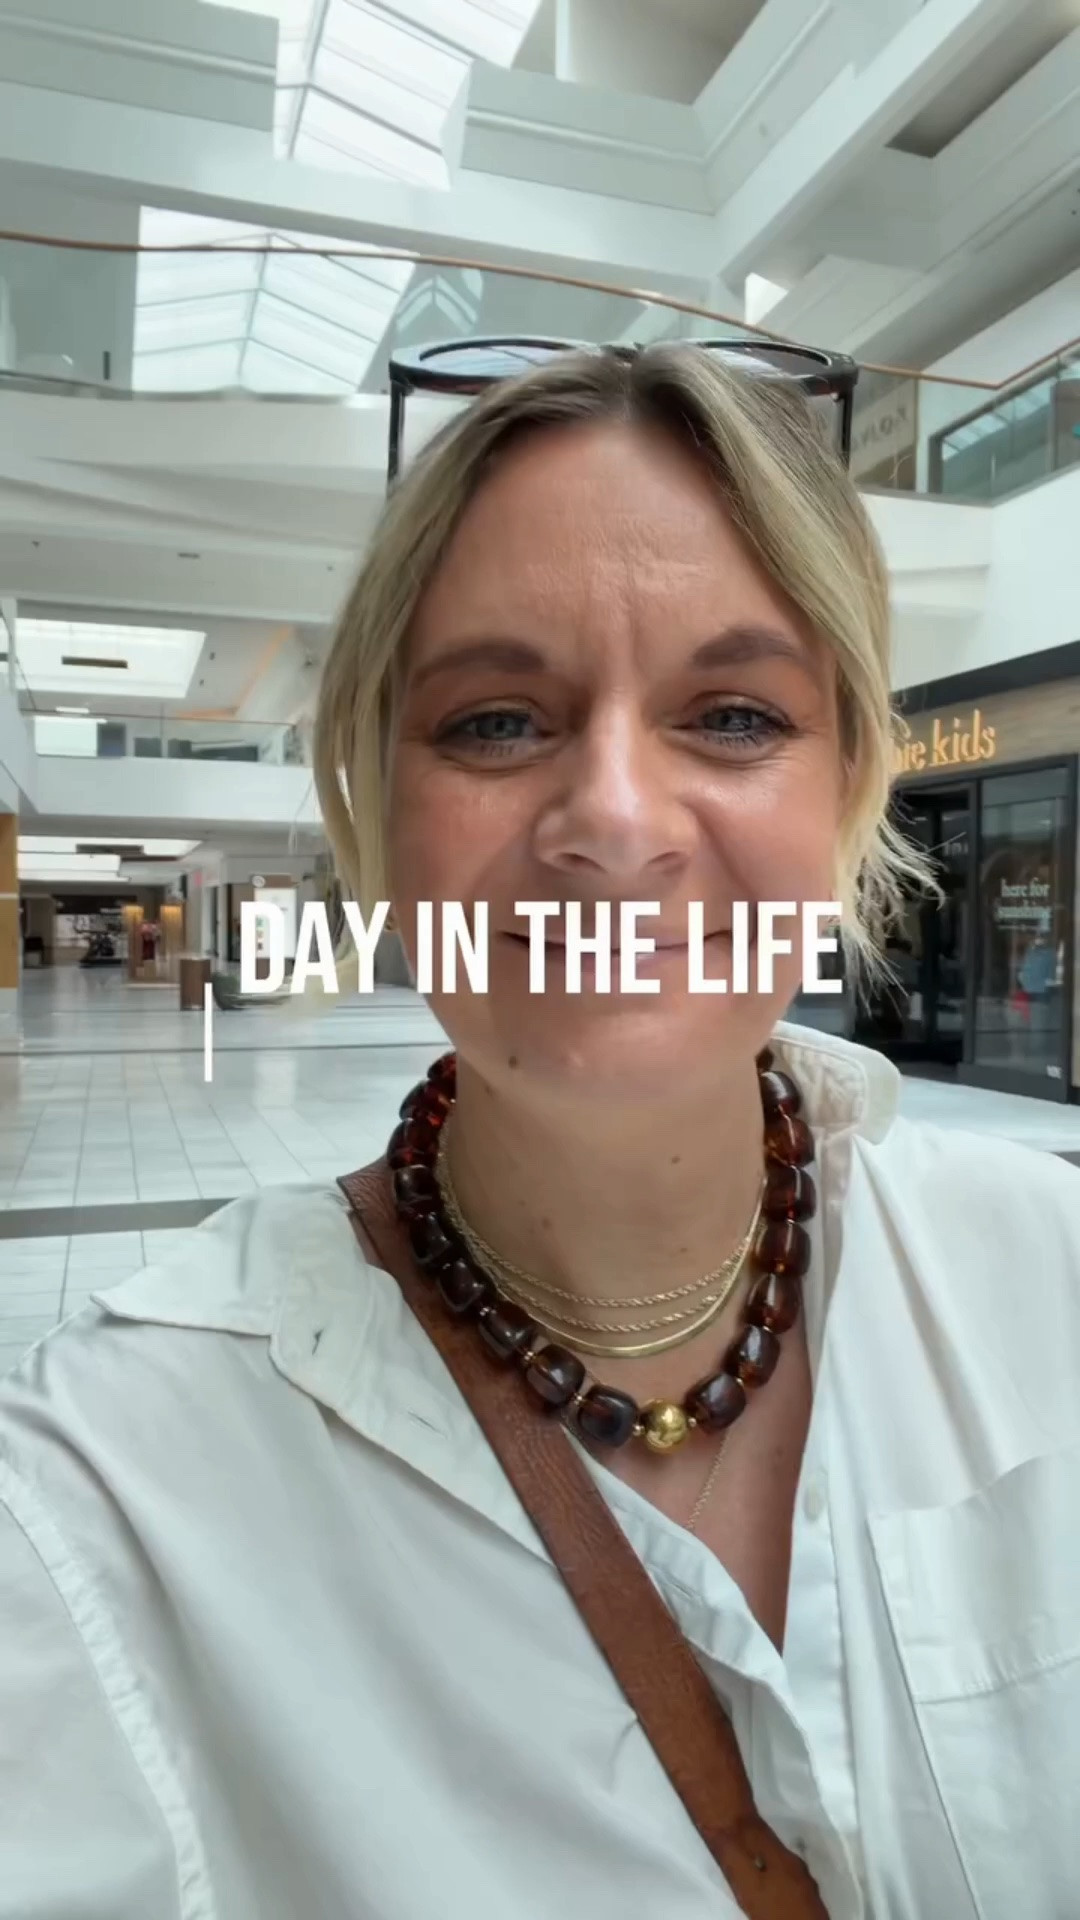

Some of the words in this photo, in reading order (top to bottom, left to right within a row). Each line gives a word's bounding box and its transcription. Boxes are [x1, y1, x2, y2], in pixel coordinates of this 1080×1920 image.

[929, 708, 996, 767] kids
[1000, 877, 1027, 898] here
[1029, 876, 1050, 897] for
